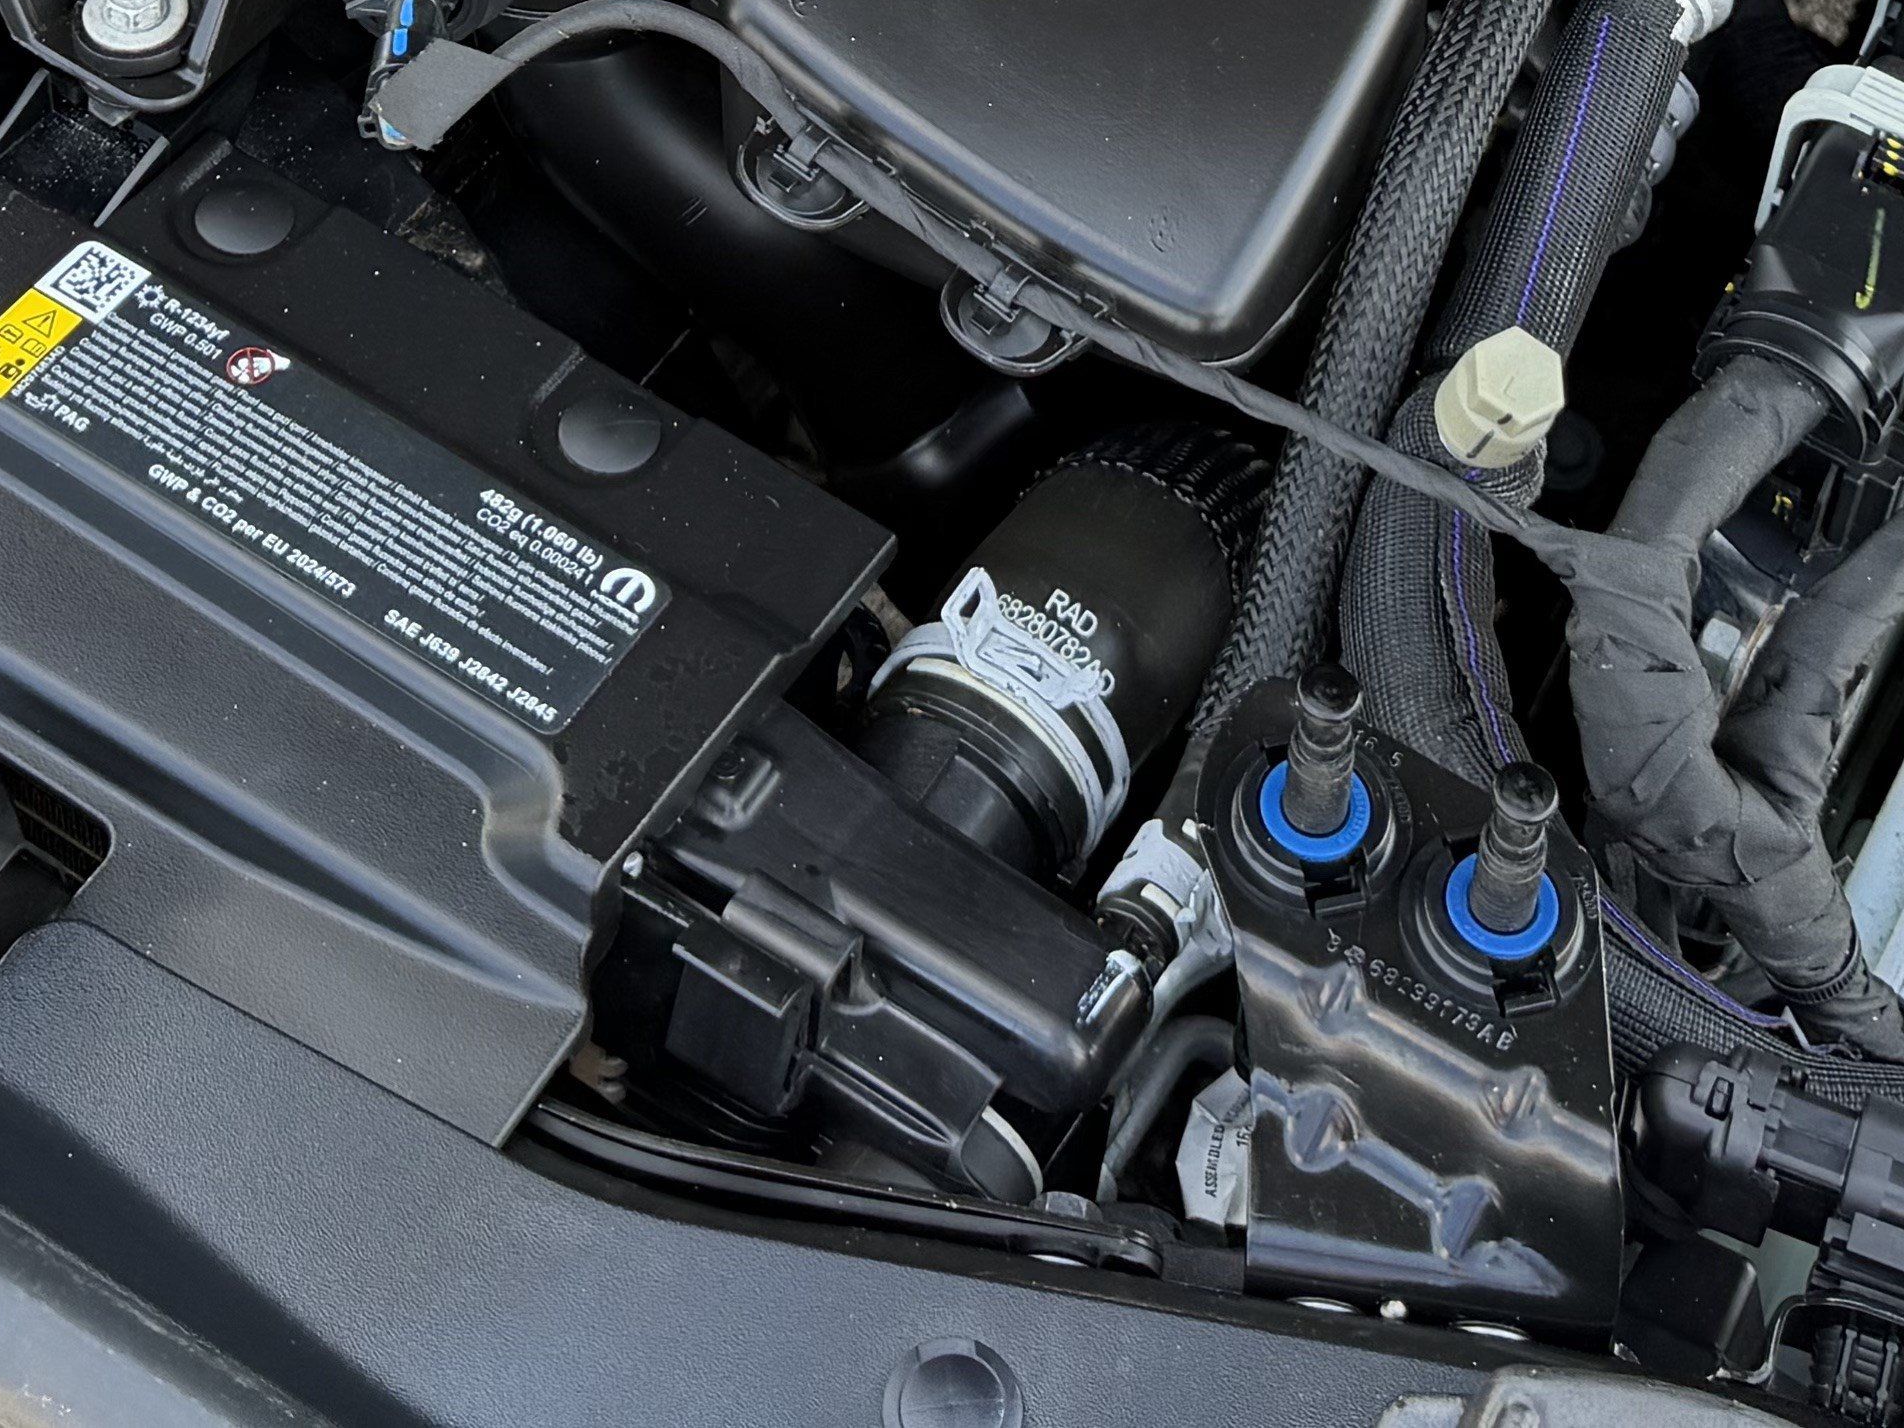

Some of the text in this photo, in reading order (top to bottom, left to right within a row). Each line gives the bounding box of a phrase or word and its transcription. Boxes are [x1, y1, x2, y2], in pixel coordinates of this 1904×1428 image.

[150, 313, 222, 360] GWP 0.501
[164, 298, 230, 342] R-1234yf
[54, 404, 90, 432] PAG
[149, 464, 357, 598] GWP & CO2 per EU 2024/573
[476, 508, 511, 534] CO2
[509, 530, 529, 549] eq
[529, 539, 586, 580] 0.00024
[479, 489, 604, 571] 482g (1.060 lb)
[1045, 588, 1098, 638] RAD
[384, 609, 558, 722] SAE J639 J2842 J2845
